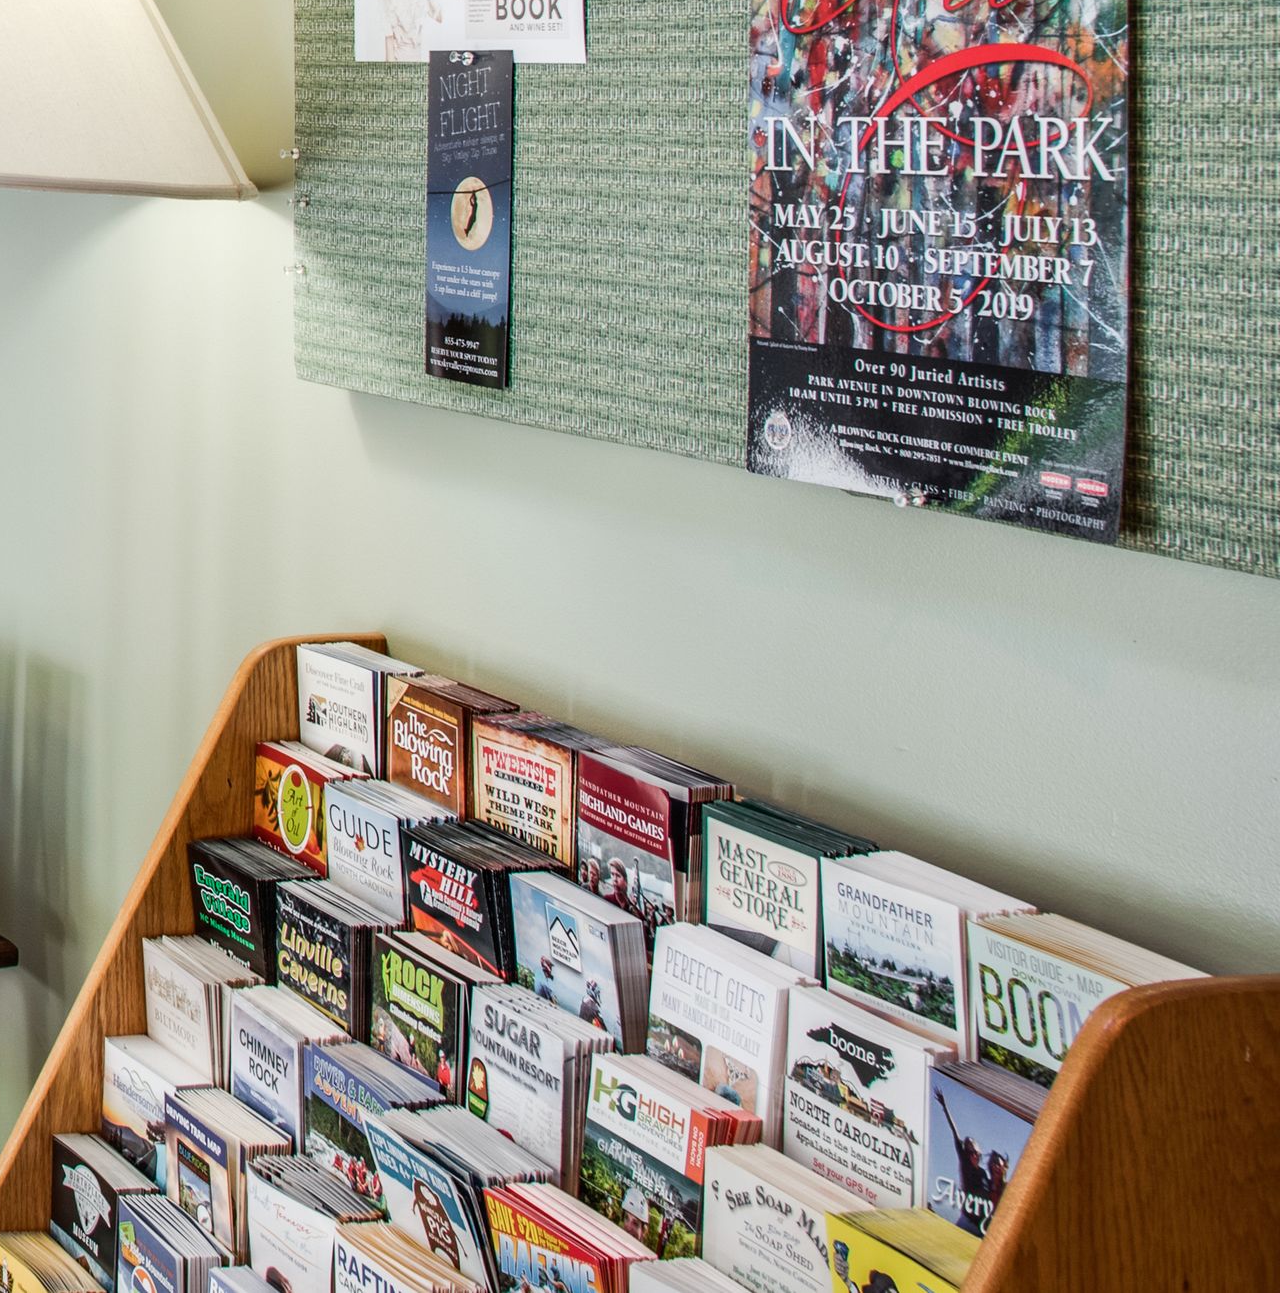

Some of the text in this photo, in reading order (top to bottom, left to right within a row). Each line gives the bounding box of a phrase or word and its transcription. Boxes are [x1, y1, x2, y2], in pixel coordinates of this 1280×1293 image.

[526, 23, 546, 31] WINE
[548, 23, 563, 31] SET!
[440, 67, 492, 101] NIGHT
[440, 102, 500, 137] FLIGHT
[764, 116, 1115, 181] IN THE PARK
[774, 203, 1097, 246] MAY 25 JUNE 15 JULY 13
[776, 238, 1094, 286] AUGUST 10 SEPTEMBER 7
[829, 277, 943, 312] OCTOBER
[977, 291, 1034, 321] 2019
[854, 359, 1006, 391] Over 90 Juried Artists
[808, 375, 1056, 421] PARK AVENUE IN DOWNTOWN BLOWING ROCK
[820, 391, 852, 406] UNTIL
[892, 402, 918, 415] FREE
[921, 408, 983, 424] ADMISSION
[998, 418, 1024, 432] FREE
[1028, 423, 1077, 441] TROLLEY
[830, 424, 1029, 465] A BLOWING ROCK CHAMBER OF COMMERCE EVENT
[839, 439, 863, 451] Blowing
[883, 446, 894, 455] NC
[872, 474, 1107, 530] METAL GLASS FIBER PAINTING PHOTOGRAPHY
[306, 662, 333, 680] Discover
[335, 672, 349, 684] Fine
[350, 678, 364, 691] Craft
[328, 701, 367, 724] SOUTHERN
[328, 713, 368, 737] HIGHLAND
[406, 710, 428, 738] The
[393, 719, 454, 777] Blowing
[411, 754, 451, 795] Rock
[482, 745, 556, 798] TWEETSIE
[284, 788, 303, 808] Art
[485, 784, 556, 820] WILD WEST
[489, 800, 553, 832] THEME PARK
[579, 776, 665, 821] GRANDFATHER MOUNTAIN
[580, 789, 664, 841] HIGHLAND GAMES
[286, 818, 300, 836] Oil
[329, 804, 393, 858] GUIDE
[334, 836, 394, 881] Blowing Rock
[409, 840, 478, 888] MYSTERY
[717, 835, 768, 872] MAST
[194, 864, 251, 915] Emerald
[336, 862, 393, 899] NORTH CAROLINA
[439, 875, 474, 907] HILL
[719, 859, 804, 913] GENERAL
[201, 889, 251, 934] Village
[732, 889, 789, 931] STORE
[837, 882, 933, 929] GRANDFATHER
[838, 898, 934, 946] MOUNTAIN
[199, 913, 255, 951] NC Mining Museum
[281, 922, 343, 978] Linville
[552, 936, 567, 946] BEECH
[552, 942, 577, 959] MOUNTAIN
[851, 920, 920, 951] NORTH CAROLINA
[553, 949, 571, 962] RESORT
[985, 936, 1103, 998] VISITOR GUIDE MAP
[278, 950, 347, 1011] Caverns
[390, 950, 445, 1007] ROCK
[665, 946, 765, 1024] PERFECT GIFTS
[1012, 967, 1082, 1003] DOWNTOWN
[392, 983, 441, 1024] DIMENSIONS
[661, 991, 760, 1058] MANY HANDCRAFTED LOCALLY
[154, 1008, 196, 1043] BILTMORE
[484, 1004, 541, 1059] SUGAR
[239, 1027, 290, 1079] CHIMNEY
[471, 1026, 517, 1066] MOUNTAIN
[519, 1058, 561, 1091] RESORT
[248, 1057, 280, 1094] ROCK
[314, 1055, 385, 1117] RIVER & EART
[593, 1068, 685, 1134] HG HIGH
[166, 1103, 221, 1156] DRIVING TRAIL MAP
[637, 1111, 684, 1143] GRAVITY
[638, 1122, 683, 1152] ADVENTURES
[693, 1126, 698, 1139] ON
[790, 1091, 913, 1169] NORTH CAROLINA
[790, 1111, 913, 1186] Located in the heart of the
[695, 1131, 704, 1168] COUPON
[796, 1129, 902, 1196] Appalachian Mountains
[69, 1170, 105, 1207] BIRTHPLACE
[812, 1157, 878, 1201] Set your GPS for
[73, 1222, 98, 1257] MUSEUM
[427, 1215, 452, 1244] PIG
[486, 1195, 517, 1236] SAVE
[516, 1213, 539, 1243] $20
